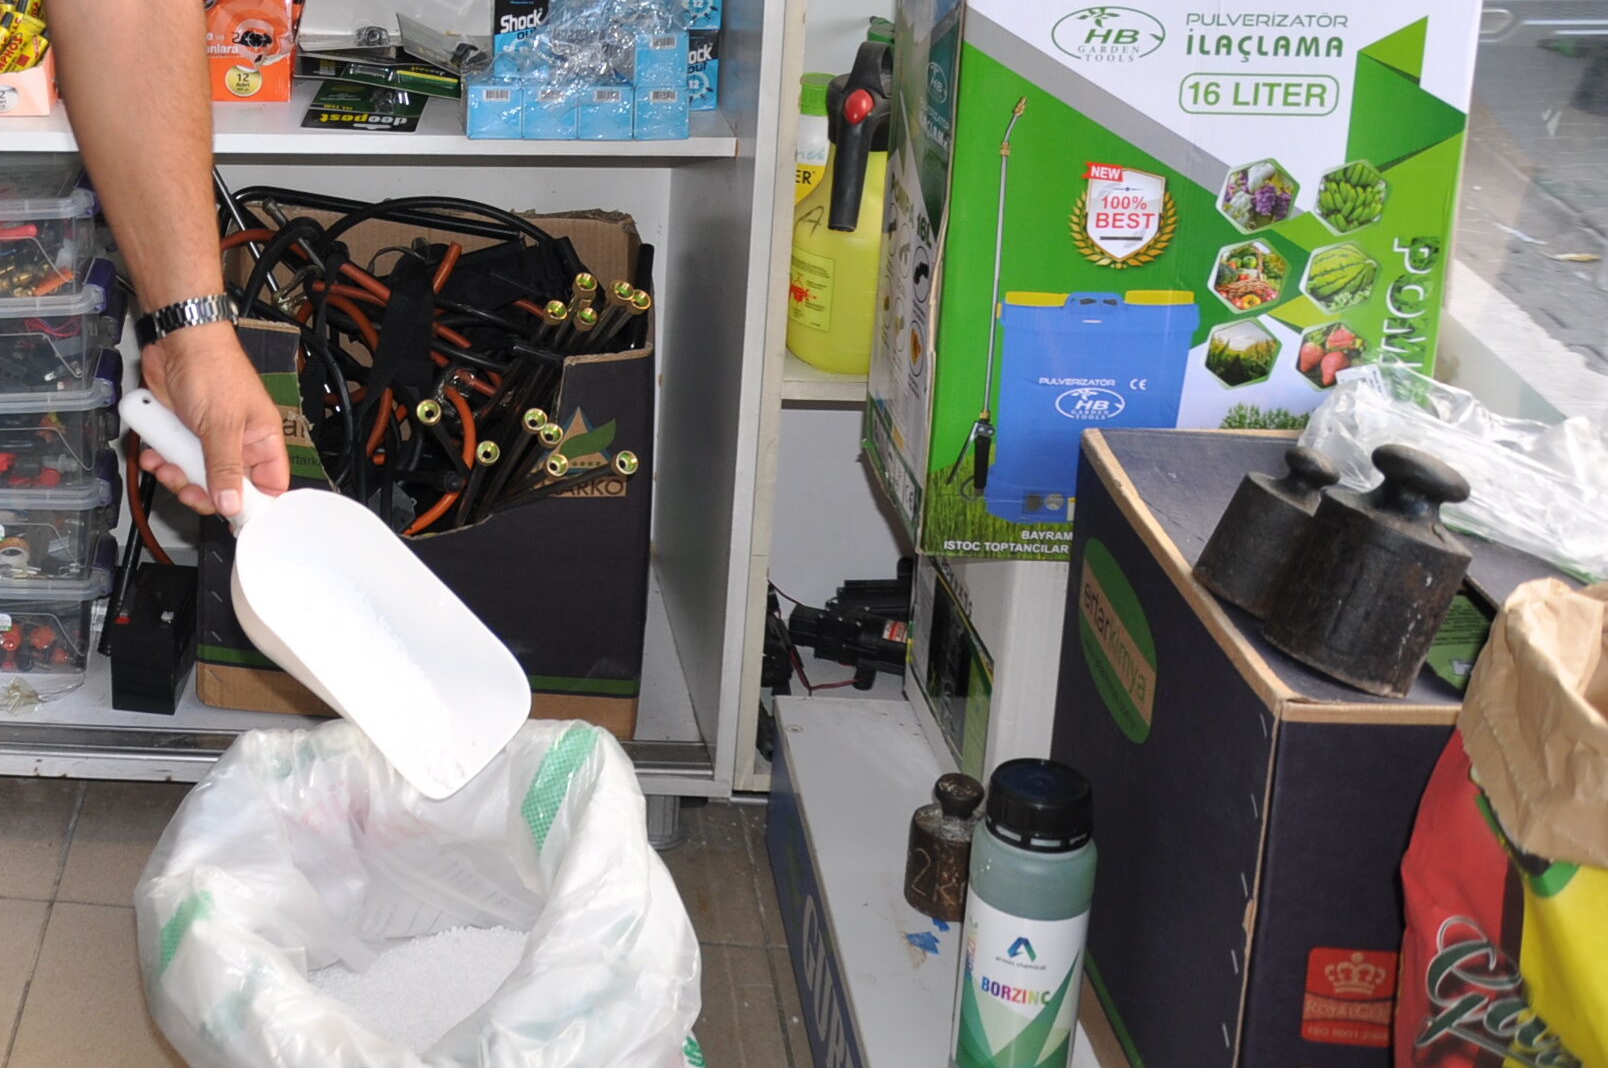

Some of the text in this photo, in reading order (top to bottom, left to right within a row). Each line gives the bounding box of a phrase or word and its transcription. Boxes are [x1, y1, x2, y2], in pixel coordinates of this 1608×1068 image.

[500, 11, 542, 33] Shock
[1186, 12, 1349, 28] PULVERİZATÖR
[1084, 28, 1140, 45] HB
[1077, 44, 1140, 55] GARDEN
[1186, 28, 1344, 63] İLAÇLAMA
[1084, 54, 1135, 63] TOOLS
[236, 73, 249, 82] 12
[1188, 81, 1328, 108] 16 LITER
[1090, 165, 1121, 180] NEW
[1101, 195, 1148, 210] 100%
[1095, 212, 1156, 229] BEST
[1129, 378, 1148, 391] CE
[1074, 399, 1110, 410] HB
[1021, 530, 1073, 541] BAYRAM
[943, 540, 1069, 554] ISTOC TOPTANCILAR
[980, 975, 1051, 1006] BORZINC
